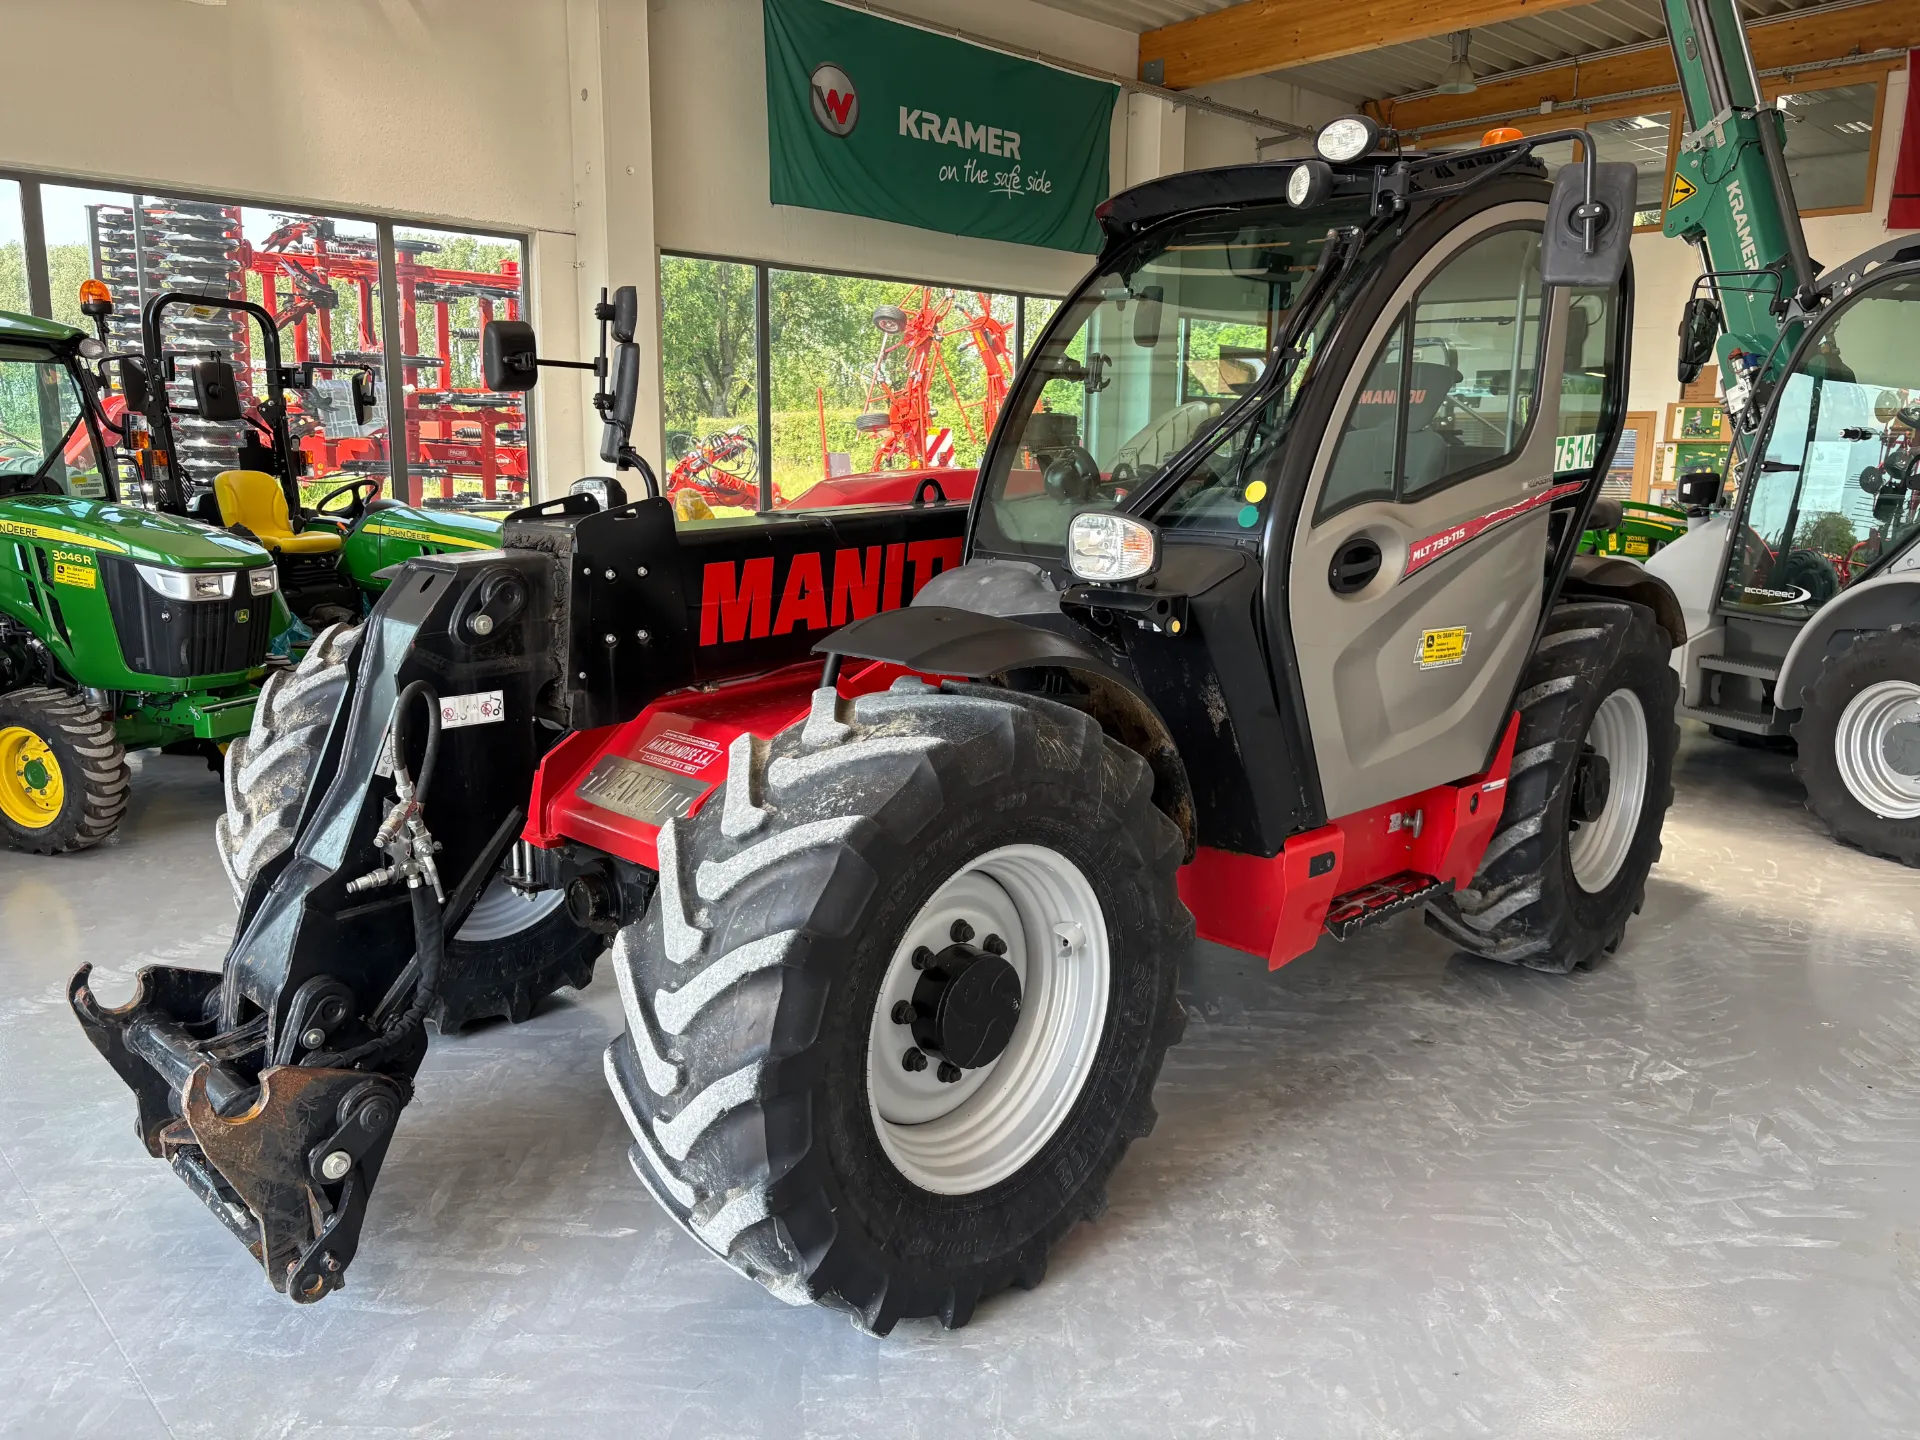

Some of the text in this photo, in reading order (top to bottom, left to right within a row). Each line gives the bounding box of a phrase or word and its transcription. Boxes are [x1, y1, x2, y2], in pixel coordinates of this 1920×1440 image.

[899, 105, 1022, 161] KRAMER
[938, 158, 1053, 199] on the safe side
[1726, 179, 1760, 278] KRAMER
[1556, 435, 1596, 471] 7514
[7, 522, 38, 537] DEERE
[386, 527, 431, 541] JOHN DEERE
[1412, 543, 1432, 562] MLT
[699, 536, 964, 647] MANIT
[1744, 586, 1796, 599] ecospeed
[646, 738, 703, 762] MARCHANDISE
